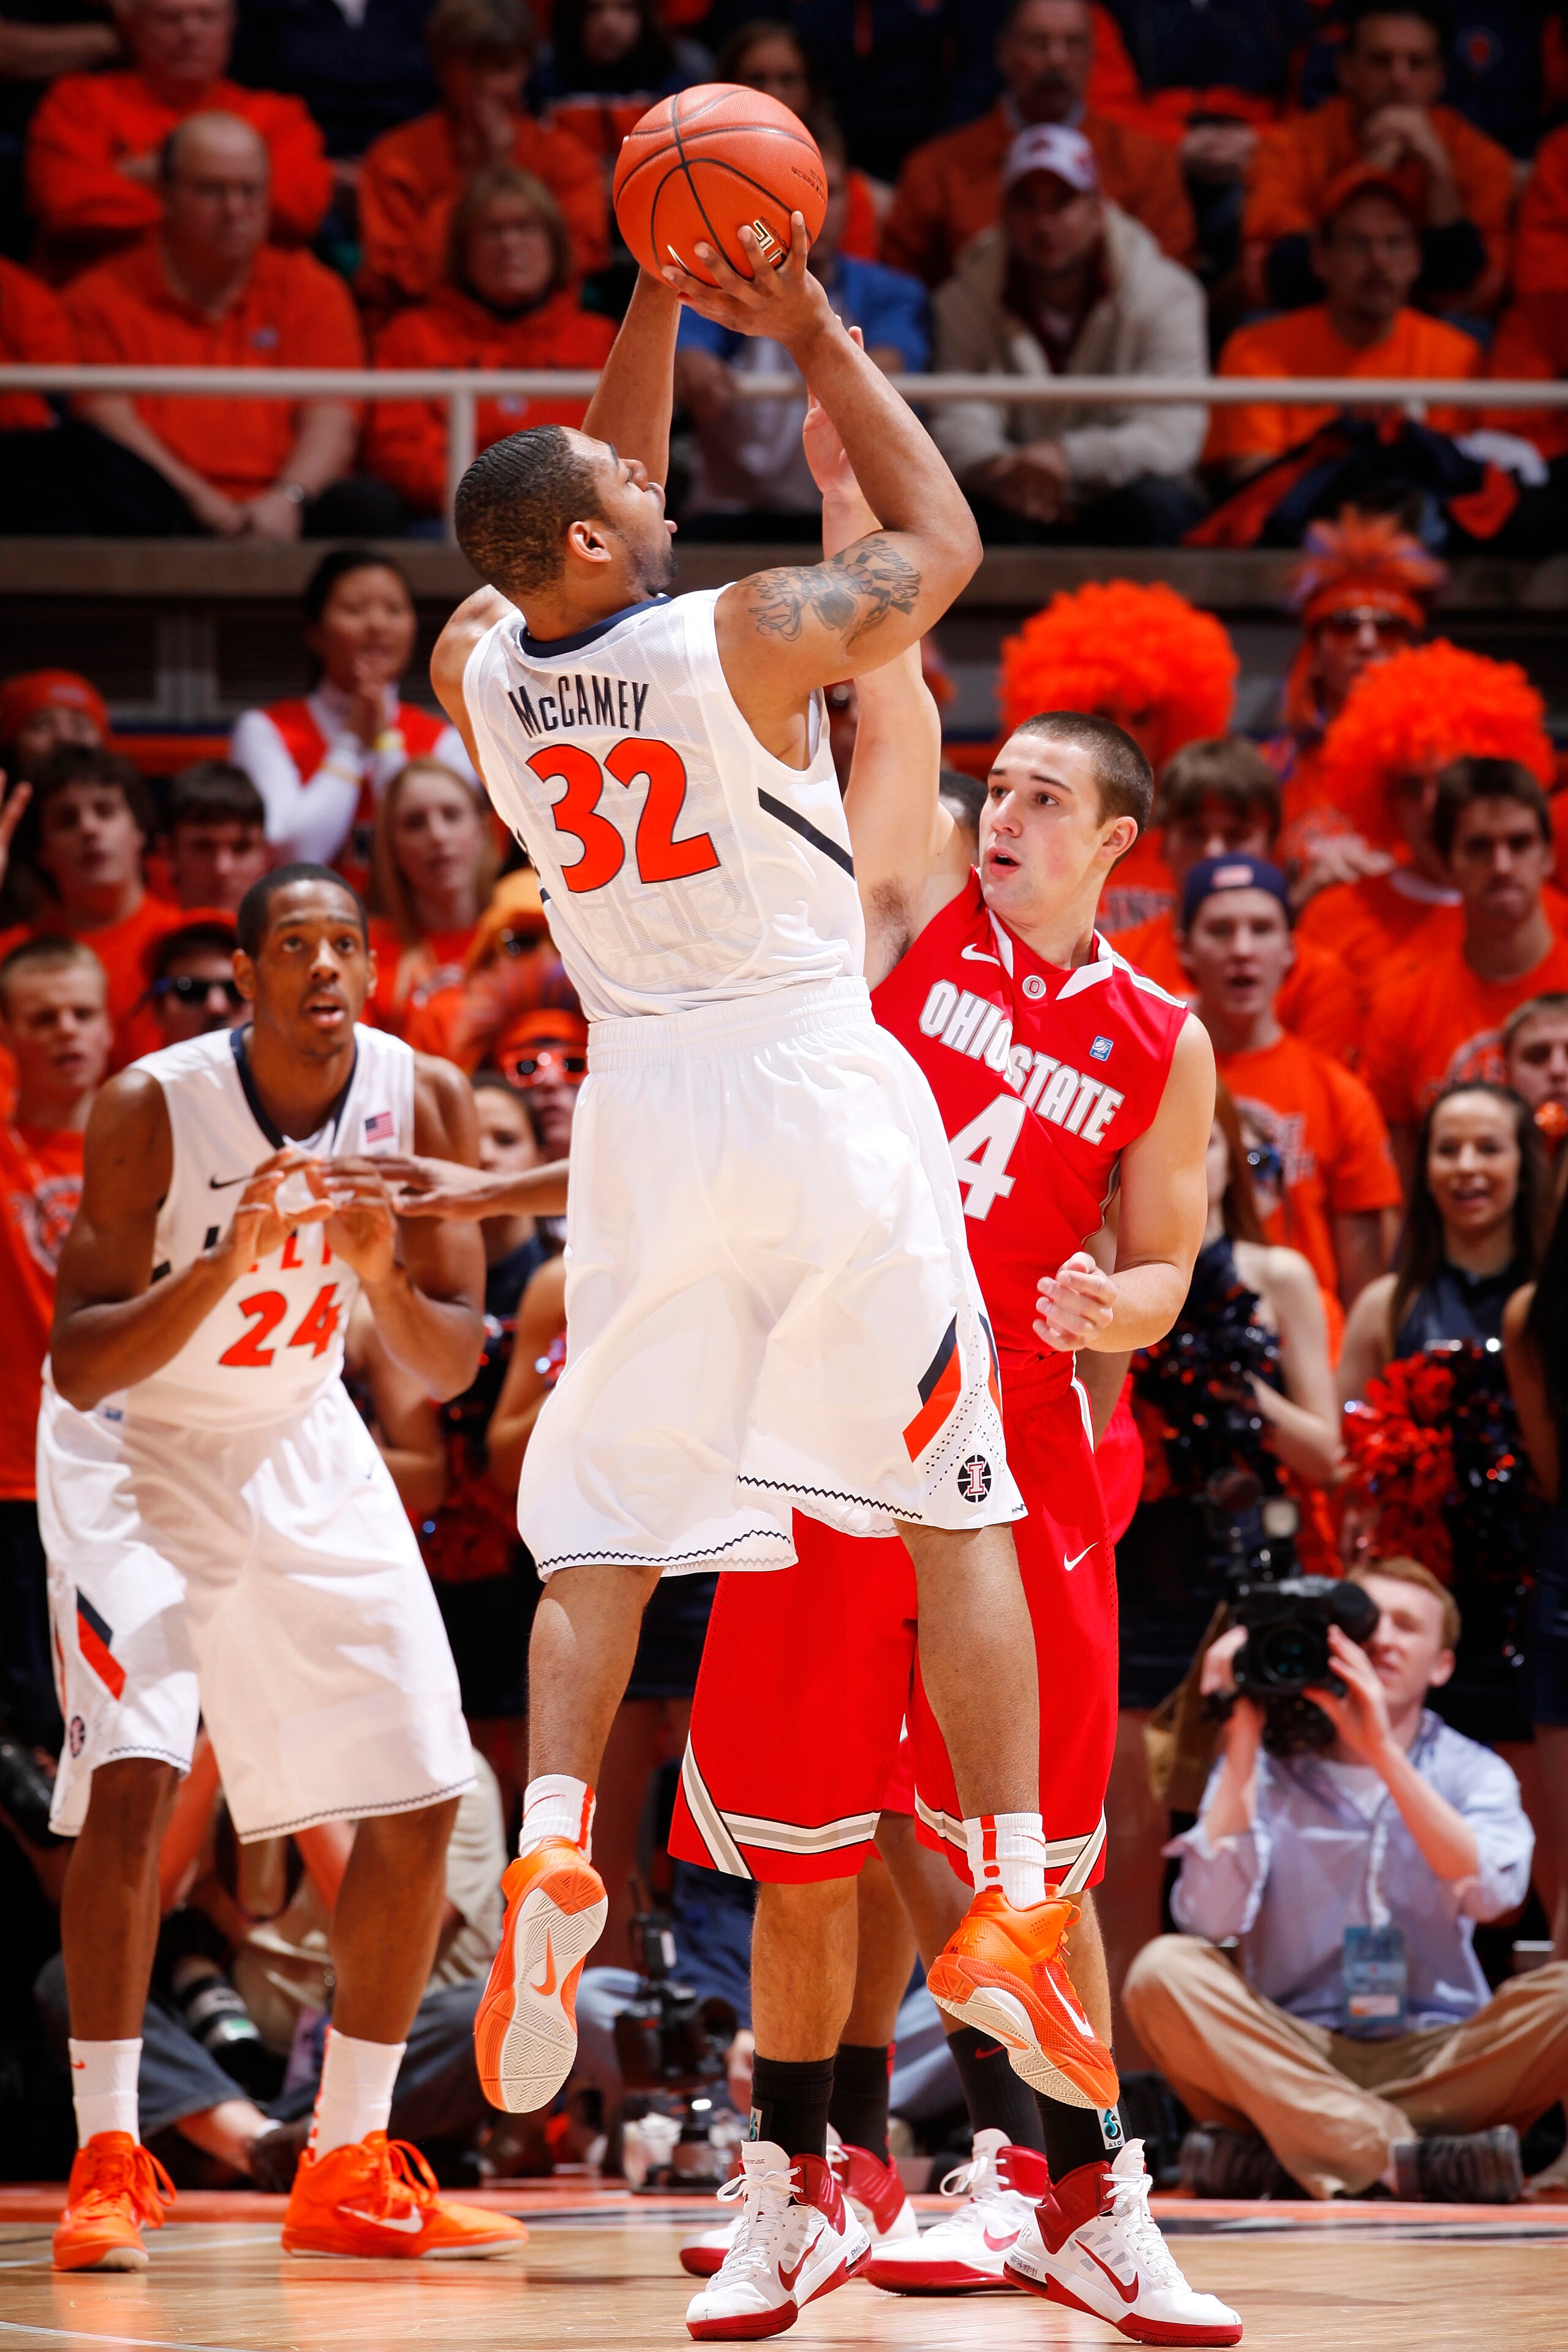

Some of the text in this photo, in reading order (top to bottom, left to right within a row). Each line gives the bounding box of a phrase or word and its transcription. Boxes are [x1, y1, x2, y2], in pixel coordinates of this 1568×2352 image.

[508, 674, 649, 738] McCAMEY
[525, 737, 722, 893] 32
[919, 979, 1125, 1146] OHIO STATE
[948, 1093, 1027, 1221] 4
[218, 1283, 343, 1367] 24
